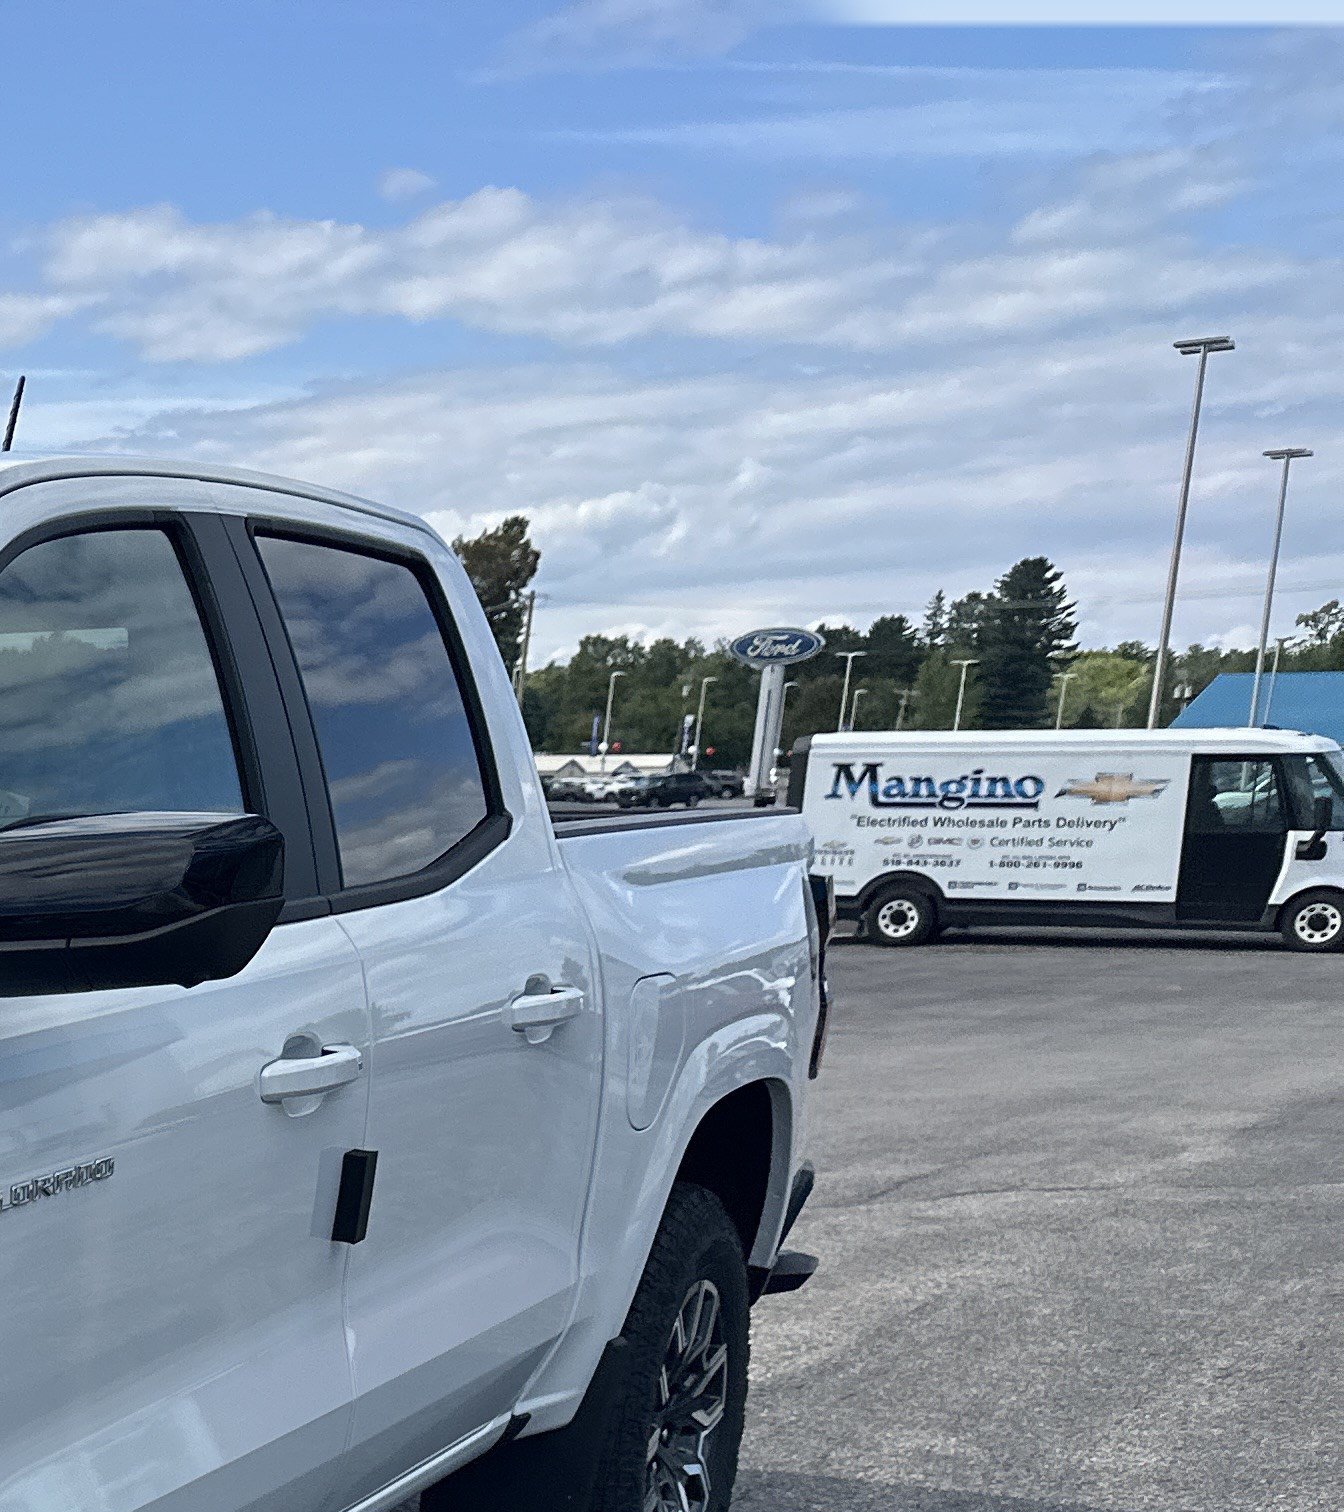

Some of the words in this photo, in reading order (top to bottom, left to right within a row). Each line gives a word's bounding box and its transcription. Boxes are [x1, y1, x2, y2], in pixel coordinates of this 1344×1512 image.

[746, 634, 802, 657] Ford
[824, 762, 1044, 810] Mangino
[933, 816, 1008, 829] Wholesale
[1012, 817, 1051, 829] Parts
[990, 837, 1043, 848] Certified
[1048, 837, 1094, 849] Service
